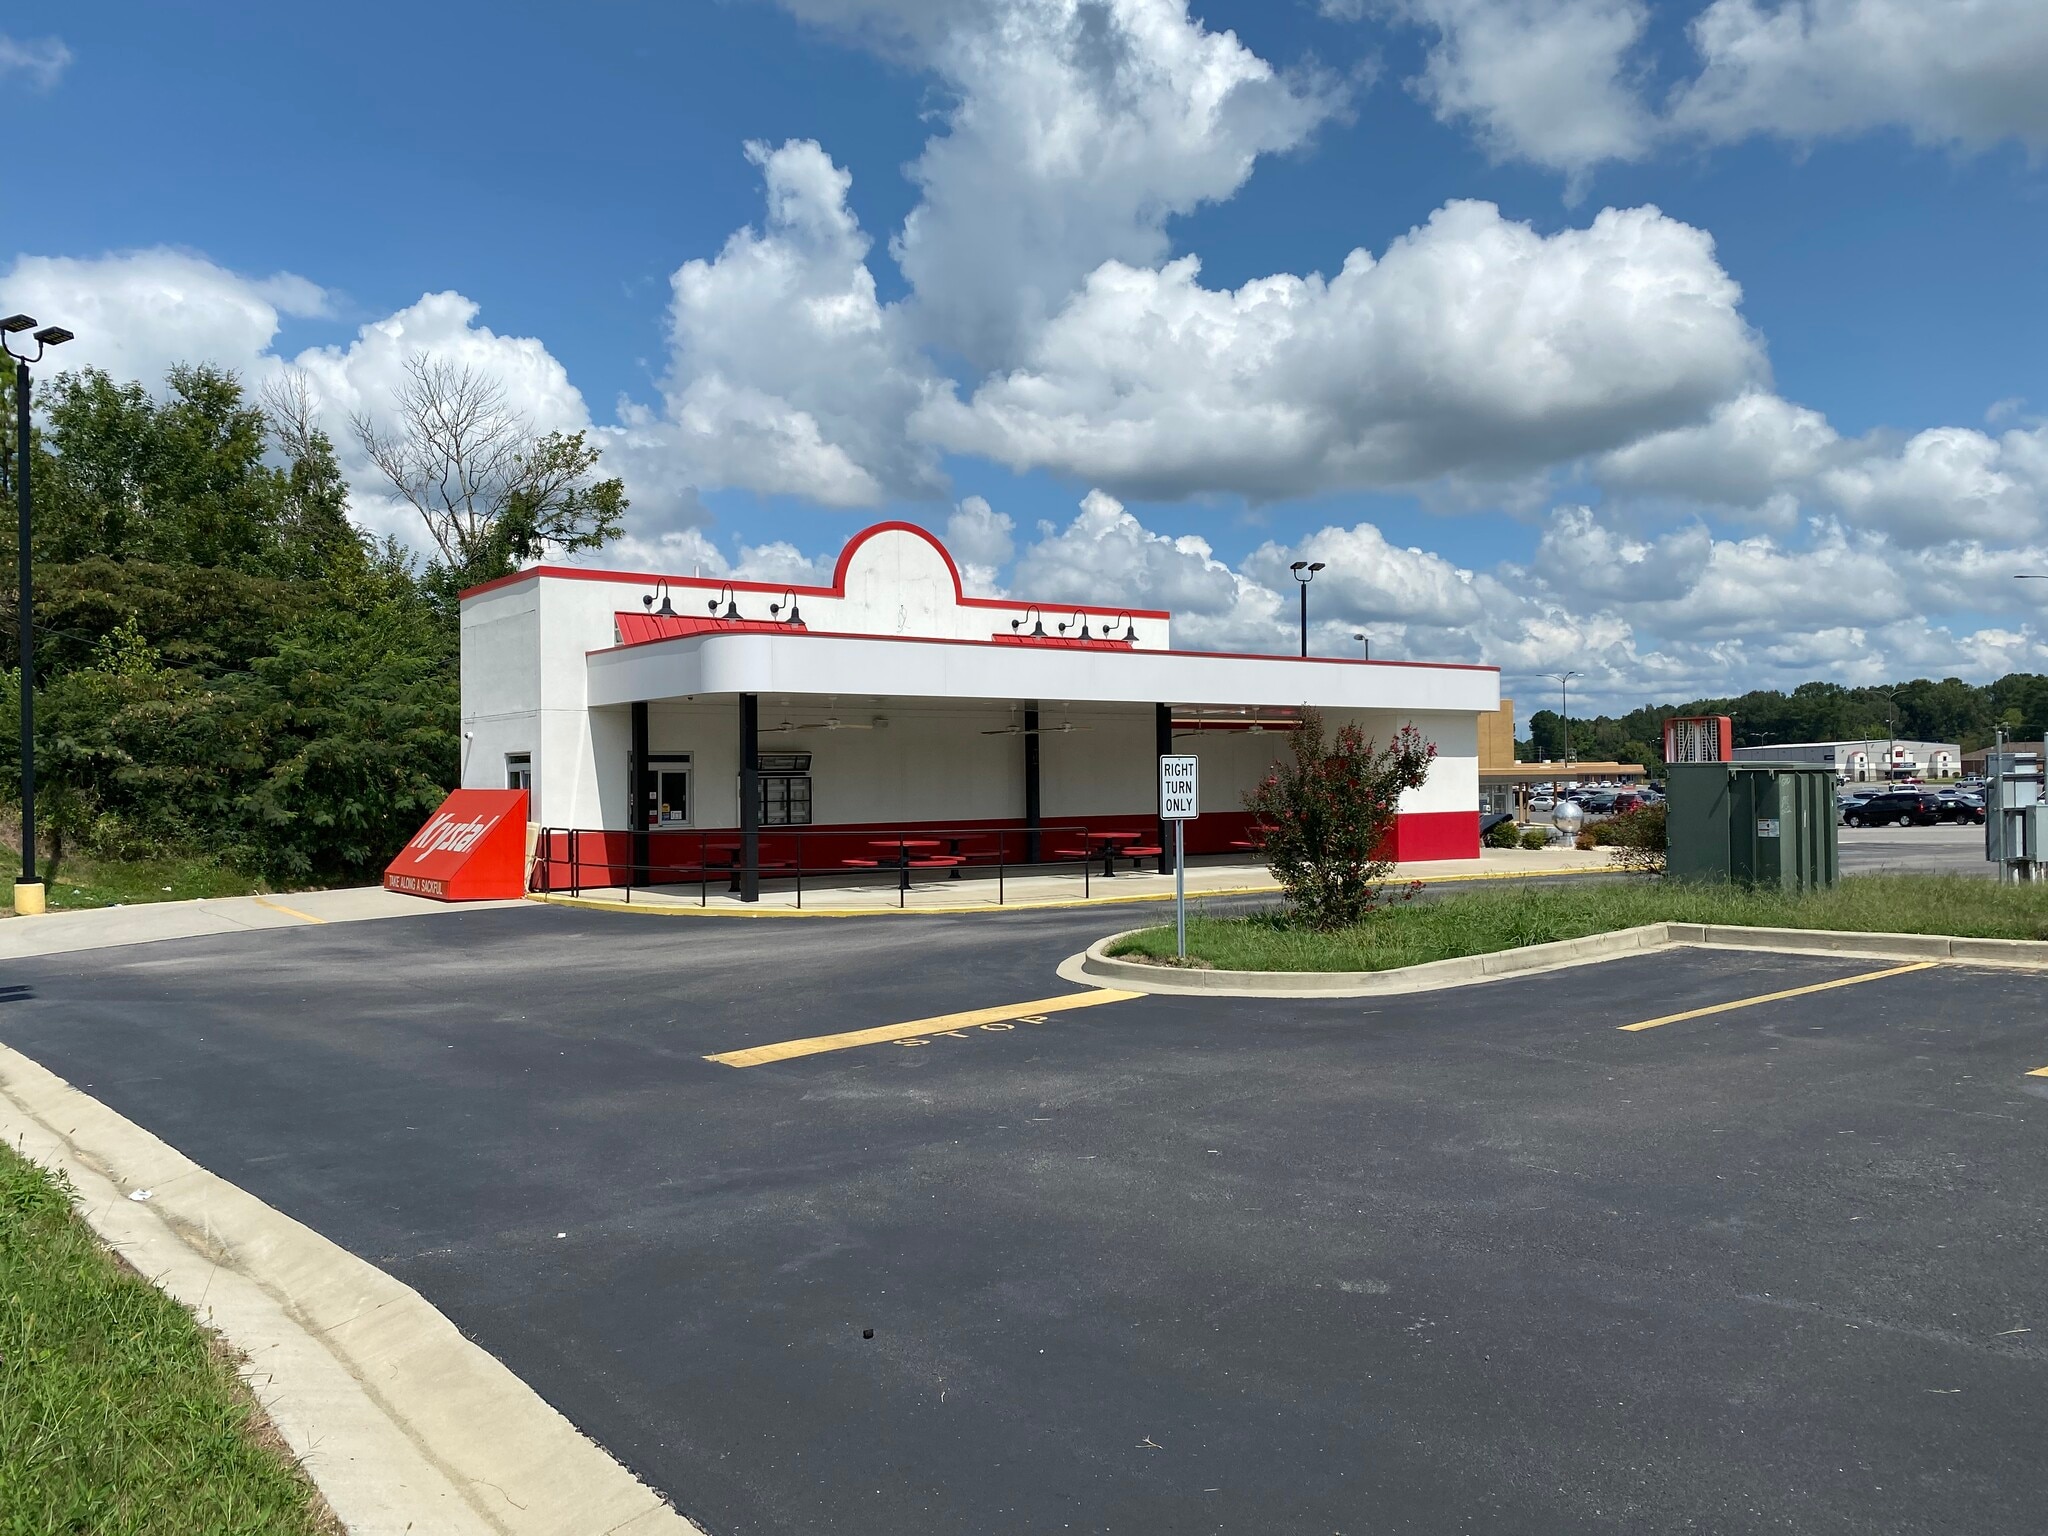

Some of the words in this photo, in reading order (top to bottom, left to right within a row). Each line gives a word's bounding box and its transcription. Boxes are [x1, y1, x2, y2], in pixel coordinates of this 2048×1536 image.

[1164, 763, 1194, 777] RIGHT
[1165, 781, 1192, 794] TURN
[1166, 798, 1193, 812] ONLY
[410, 813, 500, 863] Krystal
[389, 875, 400, 888] TAKE
[400, 876, 416, 891] ALONG
[416, 878, 421, 891] A
[421, 879, 443, 895] SACKFUL
[893, 1015, 1049, 1047] STOP
